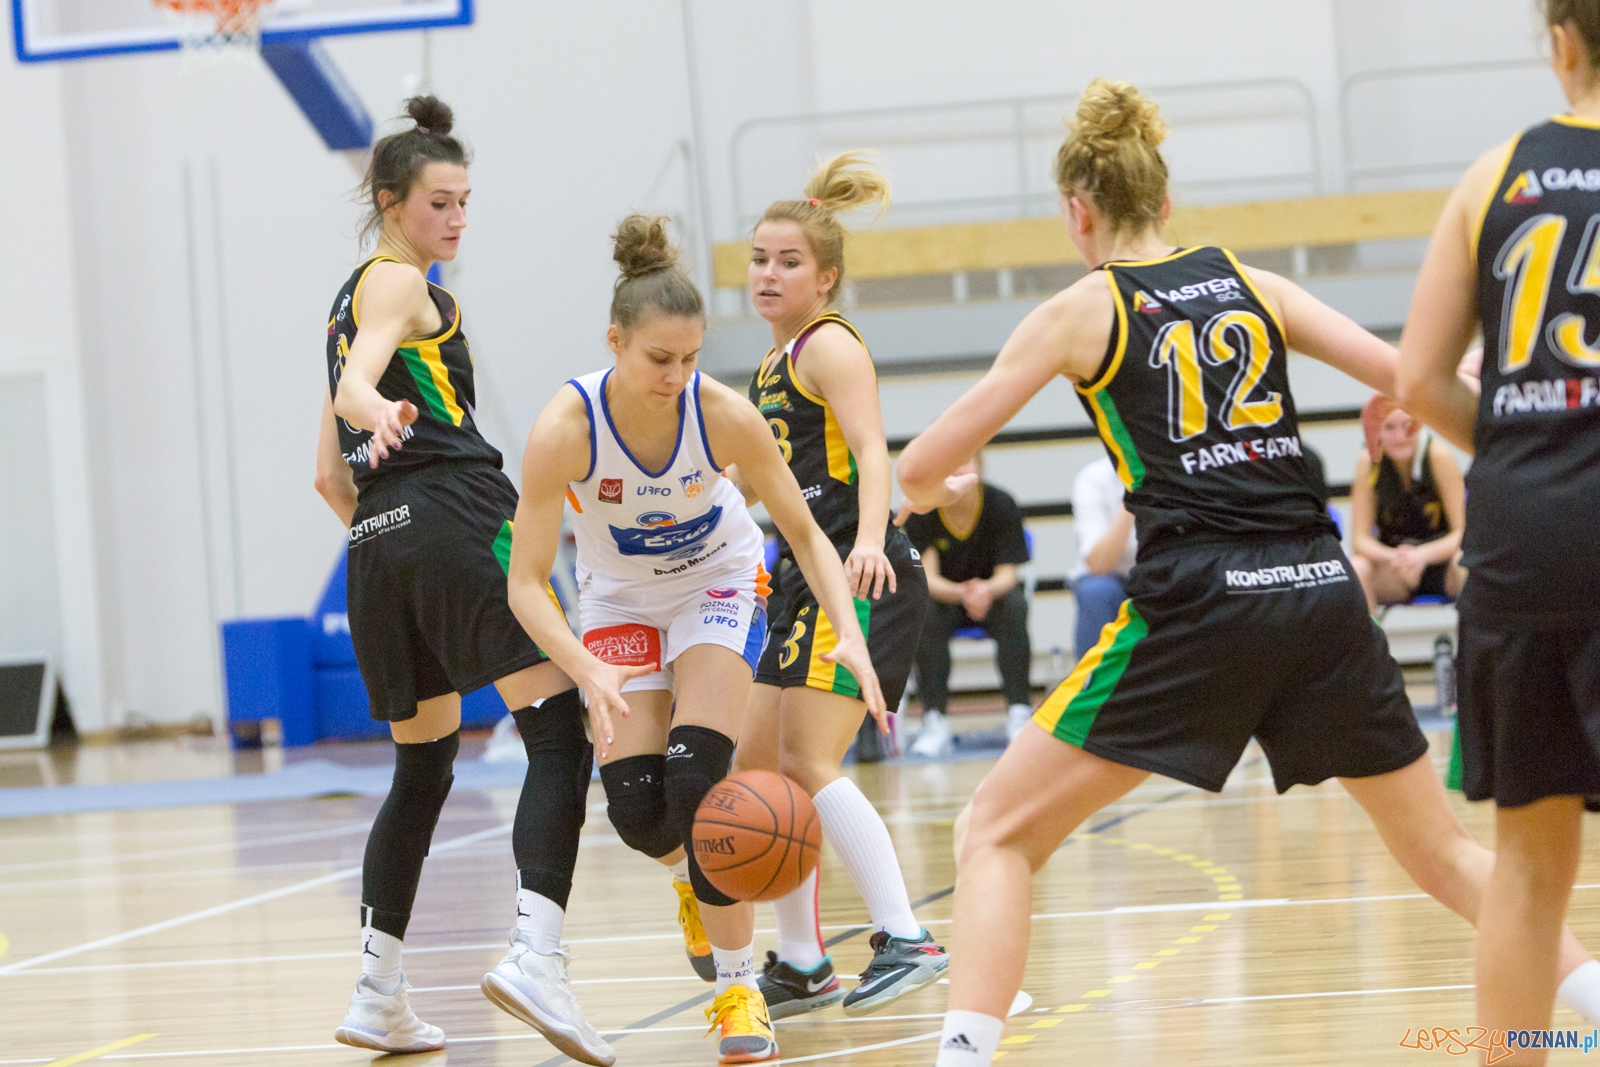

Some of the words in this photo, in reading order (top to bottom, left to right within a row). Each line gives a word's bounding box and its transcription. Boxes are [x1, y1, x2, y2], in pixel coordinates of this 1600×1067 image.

[1215, 290, 1246, 303] SOL
[1149, 310, 1284, 443] 12
[1225, 559, 1346, 587] KONSTRUKTOR
[590, 642, 649, 659] ZPIKU
